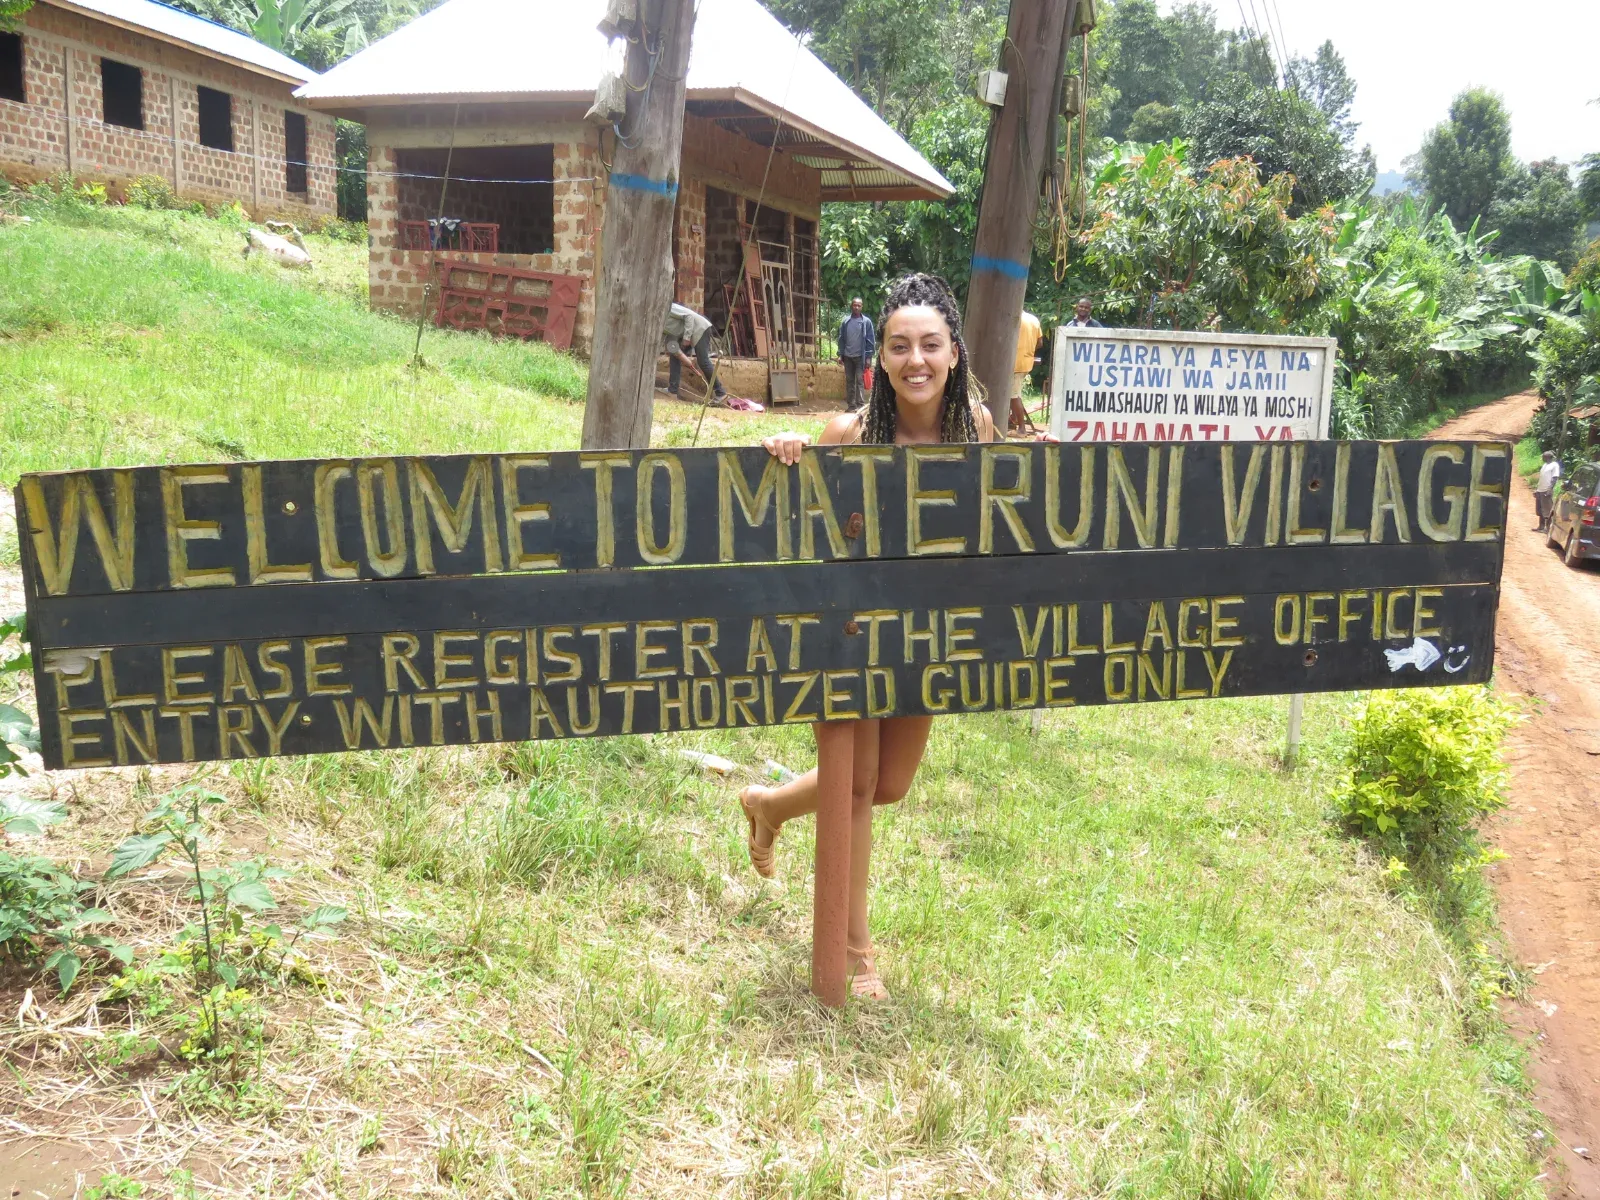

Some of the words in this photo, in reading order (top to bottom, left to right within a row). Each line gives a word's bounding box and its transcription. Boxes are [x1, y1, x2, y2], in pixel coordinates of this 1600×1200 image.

[1073, 343, 1161, 366] WIZARA
[1172, 347, 1196, 367] YA
[1210, 348, 1267, 370] AFYA
[1281, 351, 1310, 371] NA
[1088, 365, 1172, 388] USTAWI
[1183, 370, 1213, 389] WA
[1226, 371, 1287, 391] JAMII
[1065, 390, 1168, 414] HALMASHAURI
[1174, 394, 1189, 415] YA
[1194, 395, 1238, 416] WILAYA
[1243, 396, 1258, 417] YA
[21, 454, 561, 596] WELCOME
[579, 451, 687, 568] TO
[717, 444, 1184, 562] MATERUNI
[1220, 444, 1507, 546] VILLAGE
[52, 636, 353, 711] PLEASE
[381, 618, 721, 693] REGISTER
[746, 614, 821, 672] AT
[853, 606, 983, 667] THE
[1012, 596, 1245, 658] VILLAGE
[1274, 588, 1444, 646] OFFICE
[57, 702, 302, 769] ENTRY
[333, 691, 503, 750] WITH
[529, 667, 896, 740] AUTHORIZED
[921, 657, 1076, 712] GUIDE
[1103, 649, 1233, 701] ONLY
